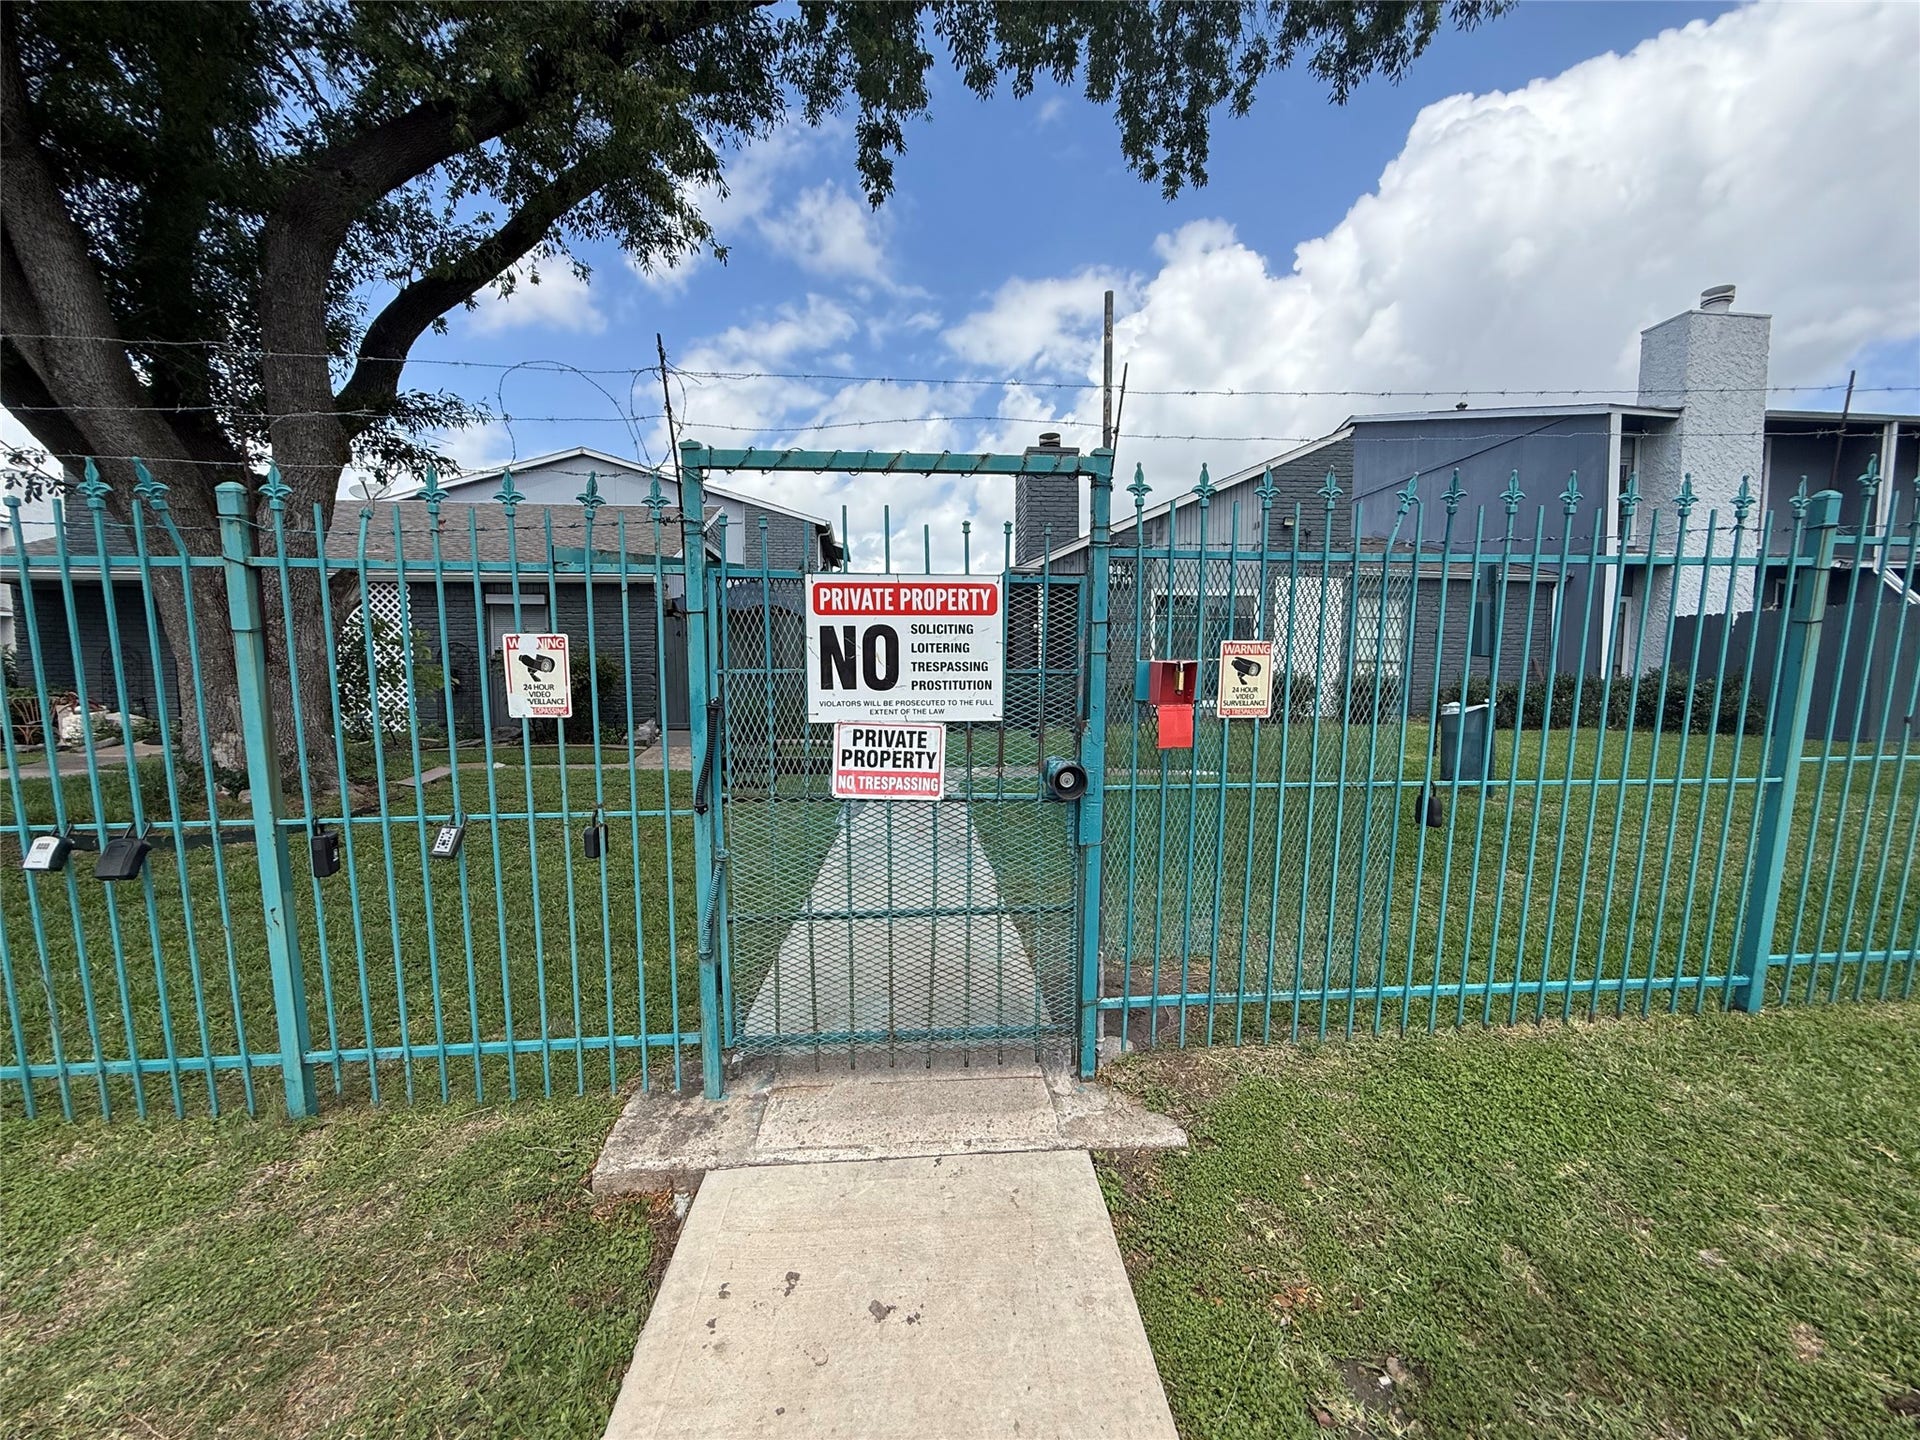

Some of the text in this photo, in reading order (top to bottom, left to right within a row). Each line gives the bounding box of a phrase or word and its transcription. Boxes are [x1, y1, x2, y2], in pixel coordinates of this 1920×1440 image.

[820, 588, 991, 611] PRIVATE PROPERTY
[911, 624, 974, 635] SOLICITING
[507, 638, 565, 649] WNING
[911, 643, 970, 653] LOITERING
[1224, 644, 1271, 654] WARNING
[819, 624, 899, 691] NO
[911, 661, 989, 672] TRESPASSING
[911, 680, 992, 691] PROSTITUTION
[852, 729, 927, 748] PRIVATE
[841, 749, 937, 769] PROPERTY
[838, 775, 938, 791] NO TRESPASSING
